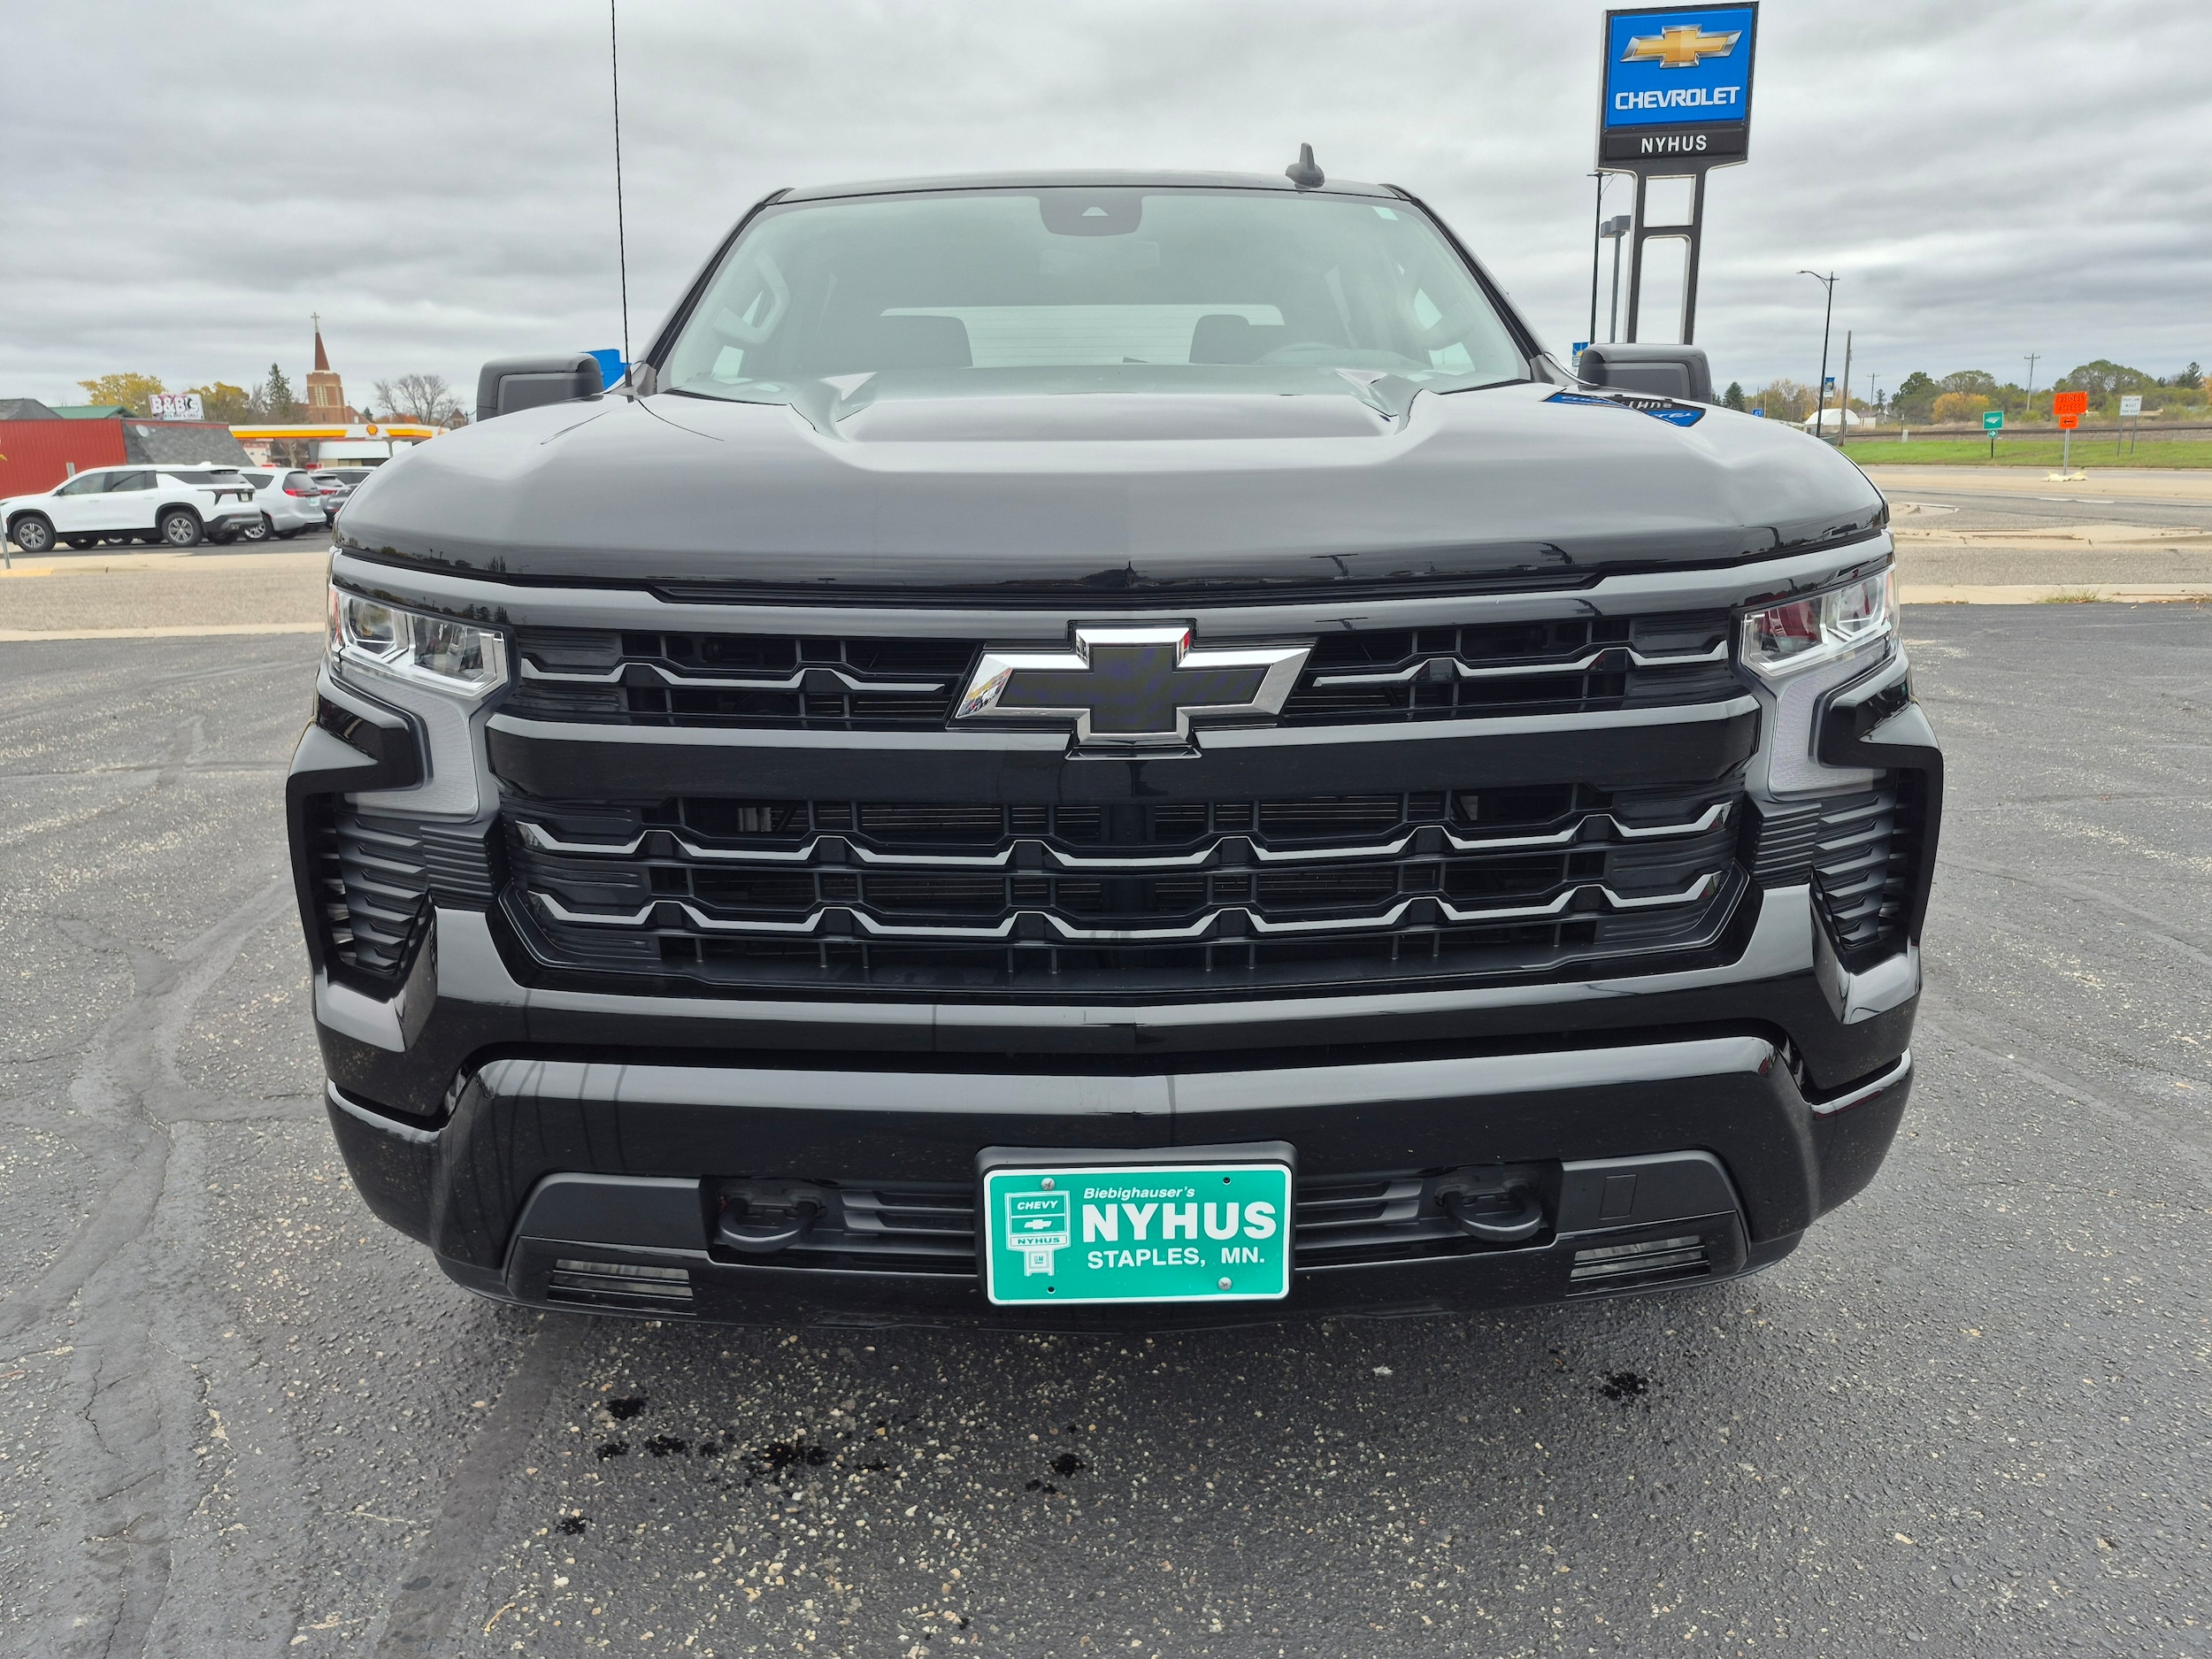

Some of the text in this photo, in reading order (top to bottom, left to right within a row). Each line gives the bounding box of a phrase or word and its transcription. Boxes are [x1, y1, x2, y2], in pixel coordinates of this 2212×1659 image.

[1615, 86, 1740, 110] CHEVROLET
[1640, 134, 1708, 153] NYHUS
[1083, 1186, 1195, 1201] Biebighauser's
[1017, 1200, 1059, 1210] CHEVY
[1081, 1201, 1277, 1243] NYHUS
[1087, 1247, 1265, 1269] STAPLES, MN.
